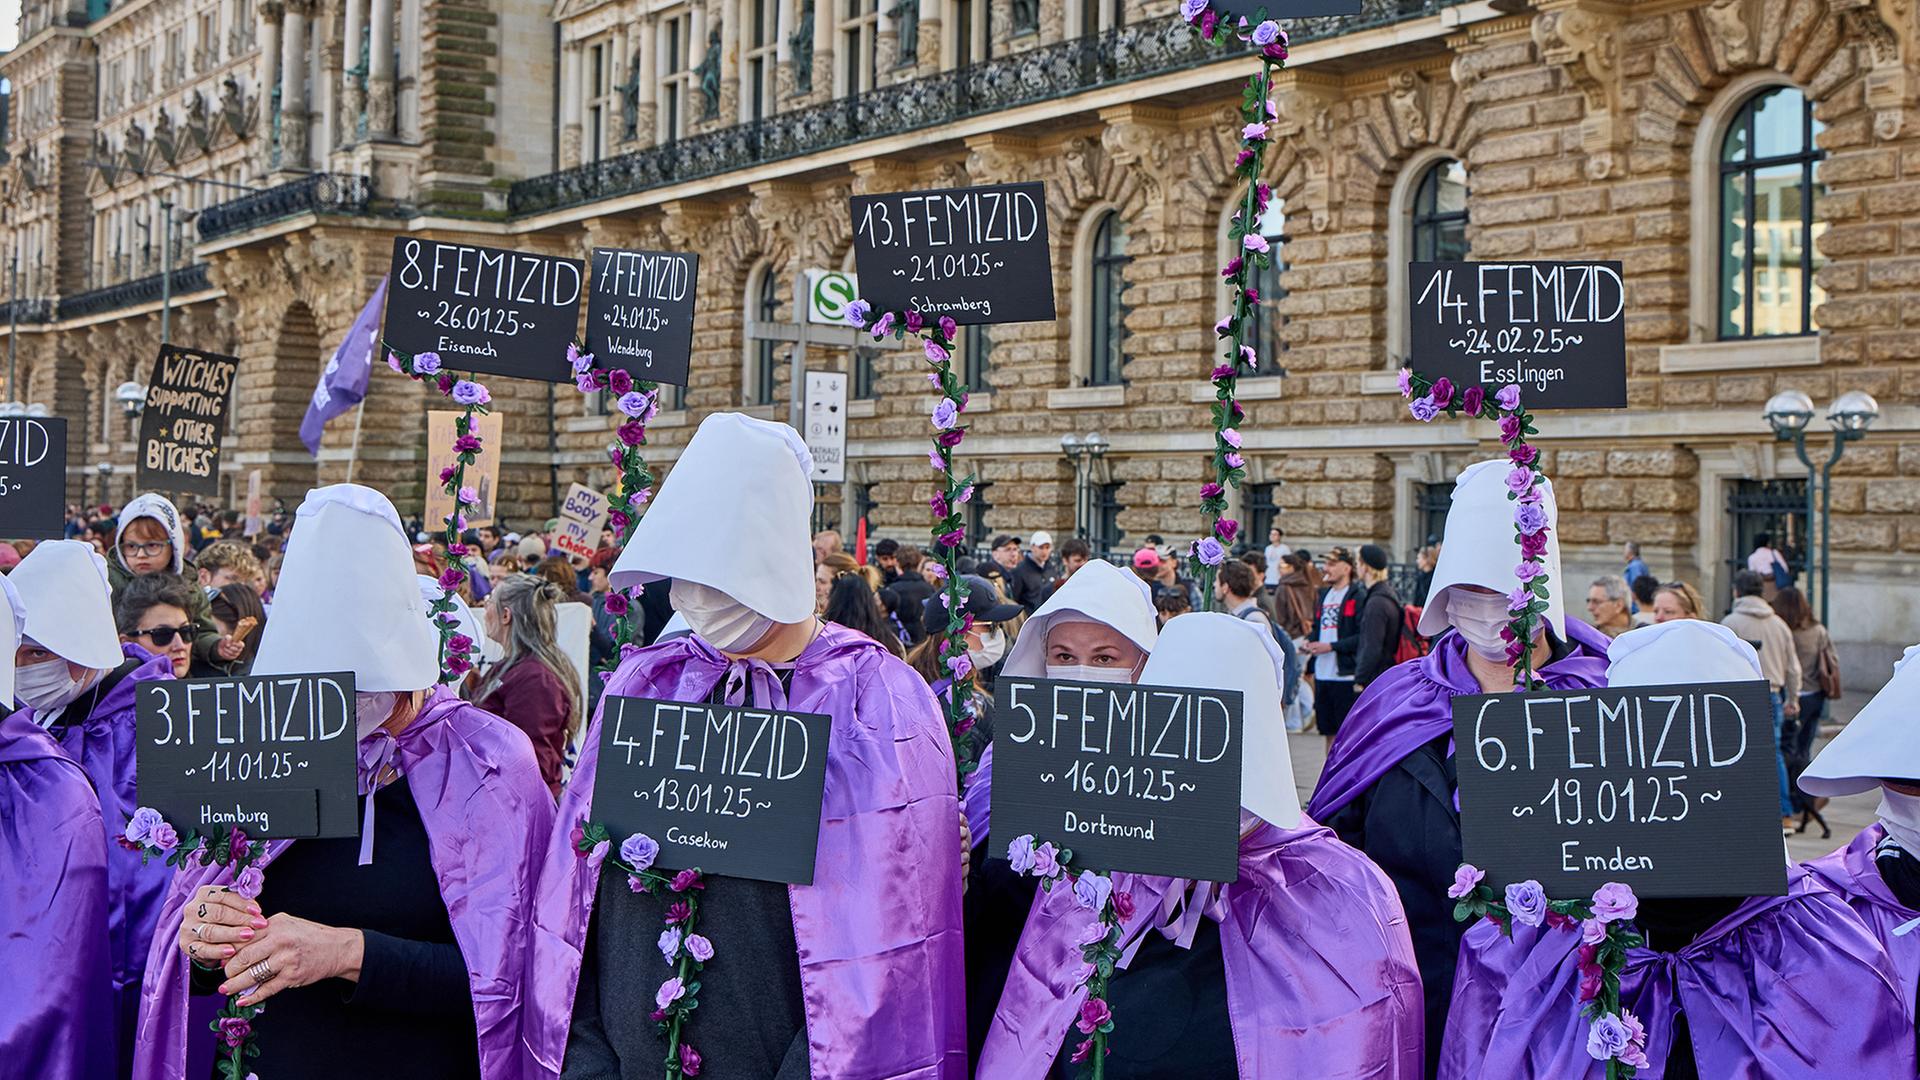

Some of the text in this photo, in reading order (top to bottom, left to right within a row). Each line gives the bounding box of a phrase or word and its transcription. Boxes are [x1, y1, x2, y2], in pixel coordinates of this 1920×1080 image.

[817, 275, 851, 319] S
[910, 296, 991, 316] Schramberg
[438, 336, 497, 357] Eisenach
[607, 336, 652, 367] Wendeburg
[162, 354, 235, 395] WITCHES
[1480, 359, 1564, 391] Esslingen
[147, 386, 223, 416] SUPPORTING
[173, 418, 215, 445] OTHER
[146, 439, 214, 478] BITCHES
[557, 534, 594, 559] Choice
[200, 804, 269, 832] Hamburg
[1064, 811, 1154, 840] Dortmund
[666, 826, 728, 850] Casekow
[1562, 840, 1654, 872] Emden
